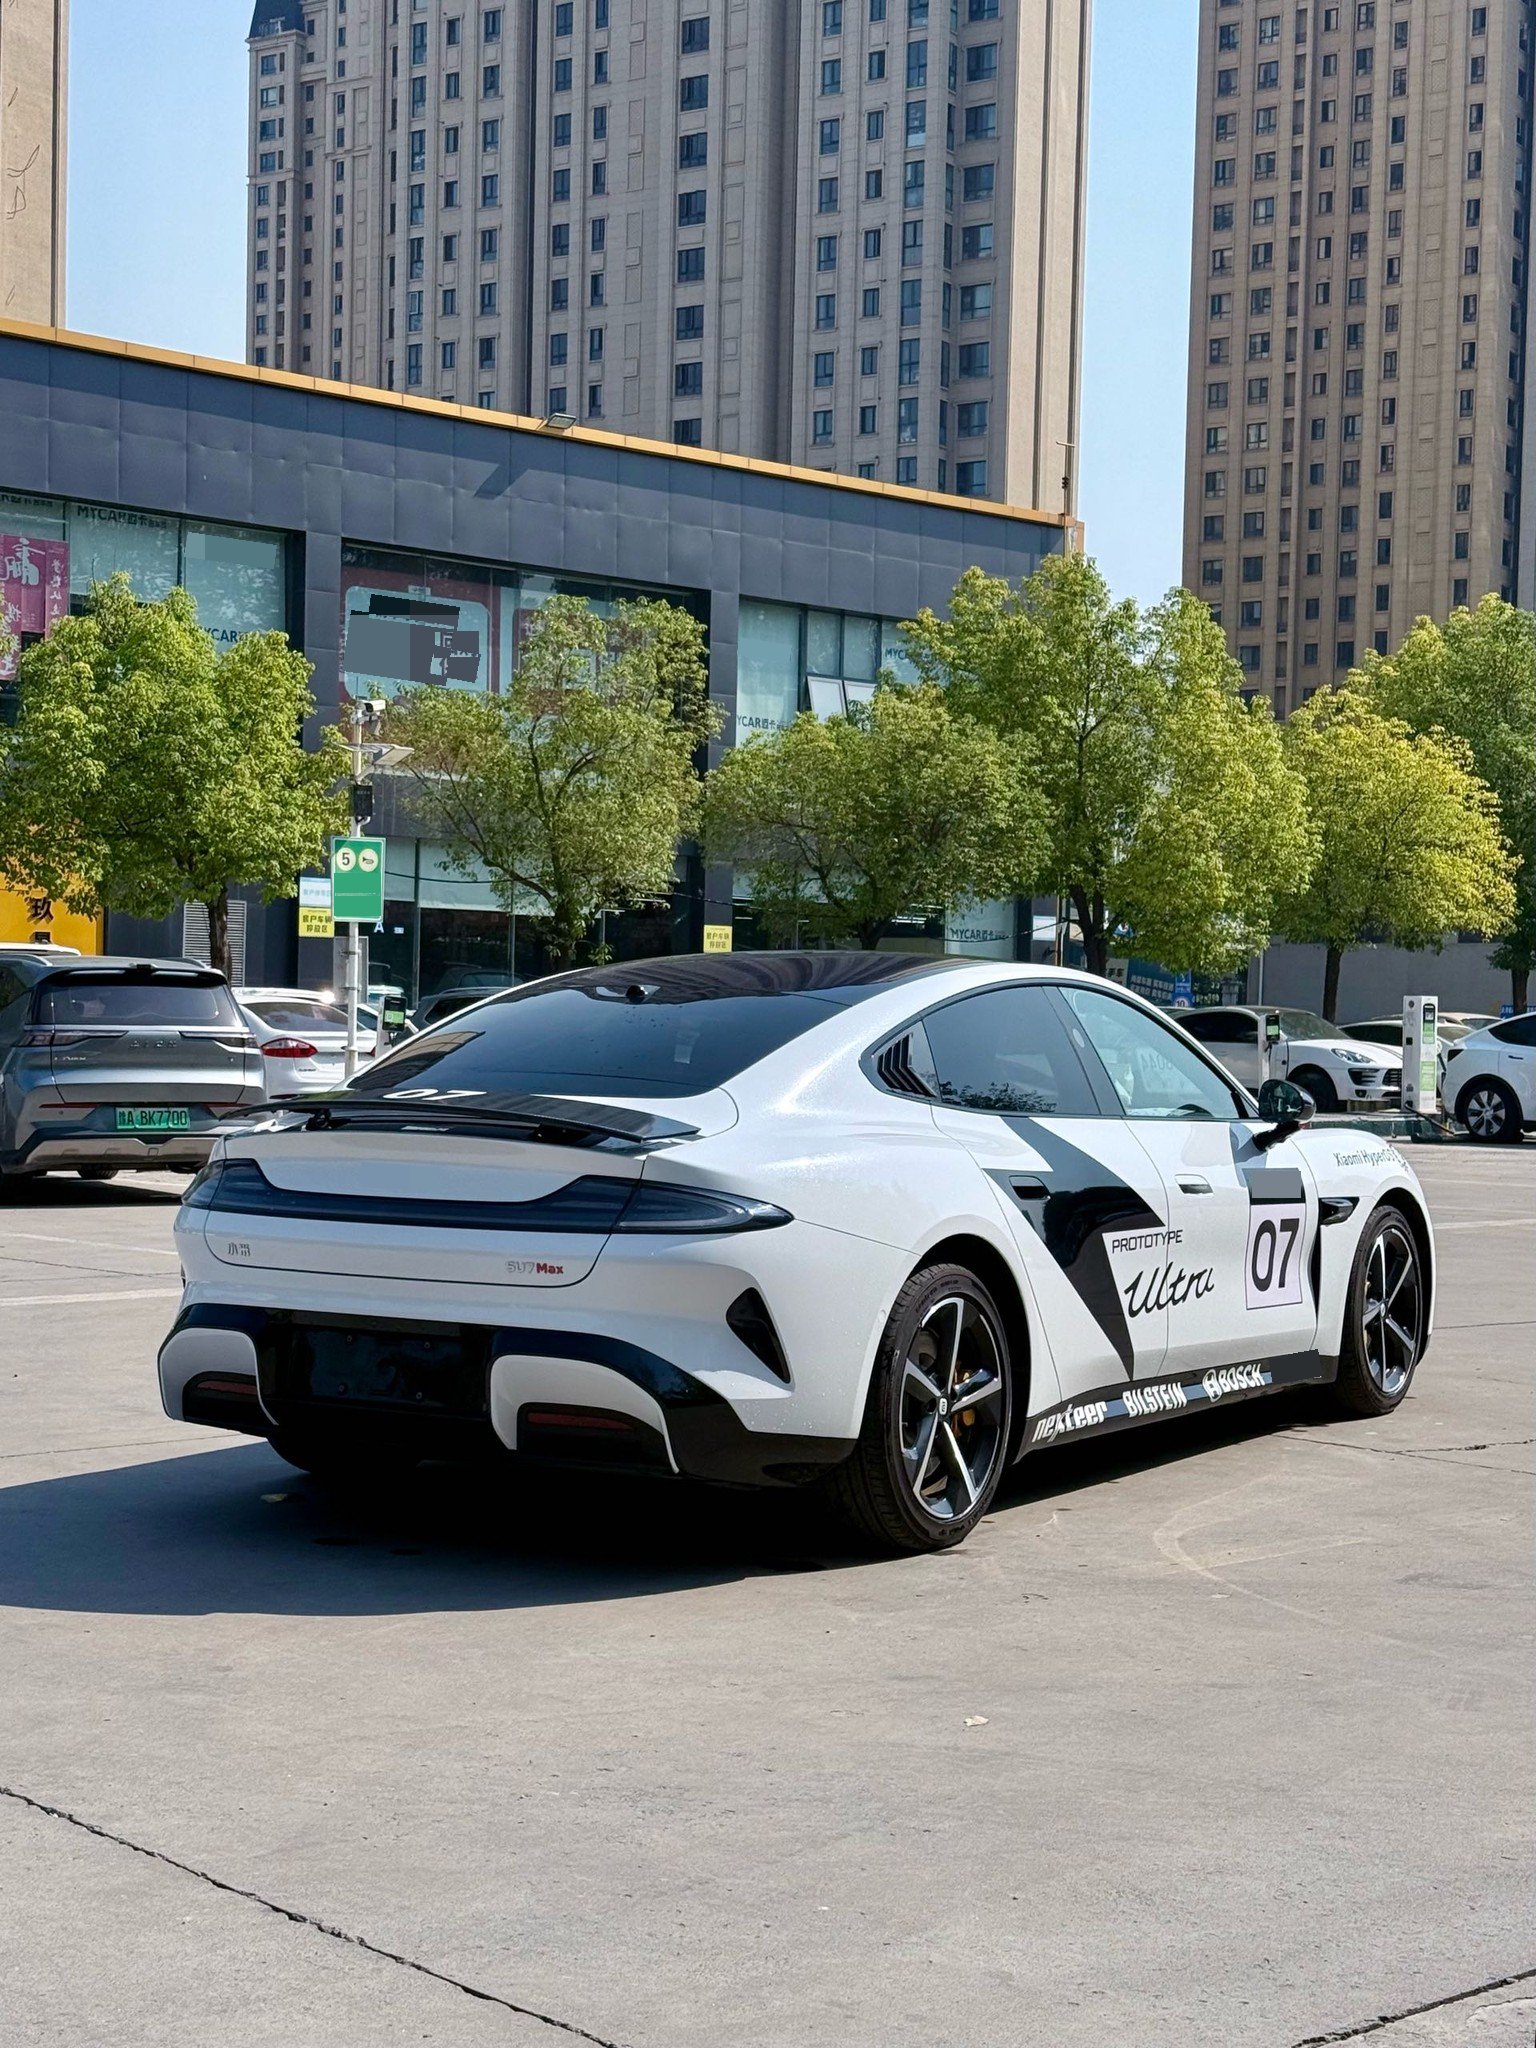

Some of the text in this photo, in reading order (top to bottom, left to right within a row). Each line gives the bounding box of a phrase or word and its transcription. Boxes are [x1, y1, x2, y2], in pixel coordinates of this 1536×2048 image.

[342, 852, 350, 866] 5
[1333, 1150, 1362, 1167] Xiaomi
[228, 1241, 251, 1257] 小米
[1112, 1229, 1184, 1254] PROTOTYPE
[1251, 1218, 1300, 1292] 07
[1124, 1261, 1215, 1319] Ultra
[1218, 1363, 1267, 1394] BOSCH
[1122, 1382, 1188, 1418] BILSTEIN
[1031, 1400, 1108, 1443] nexteer
